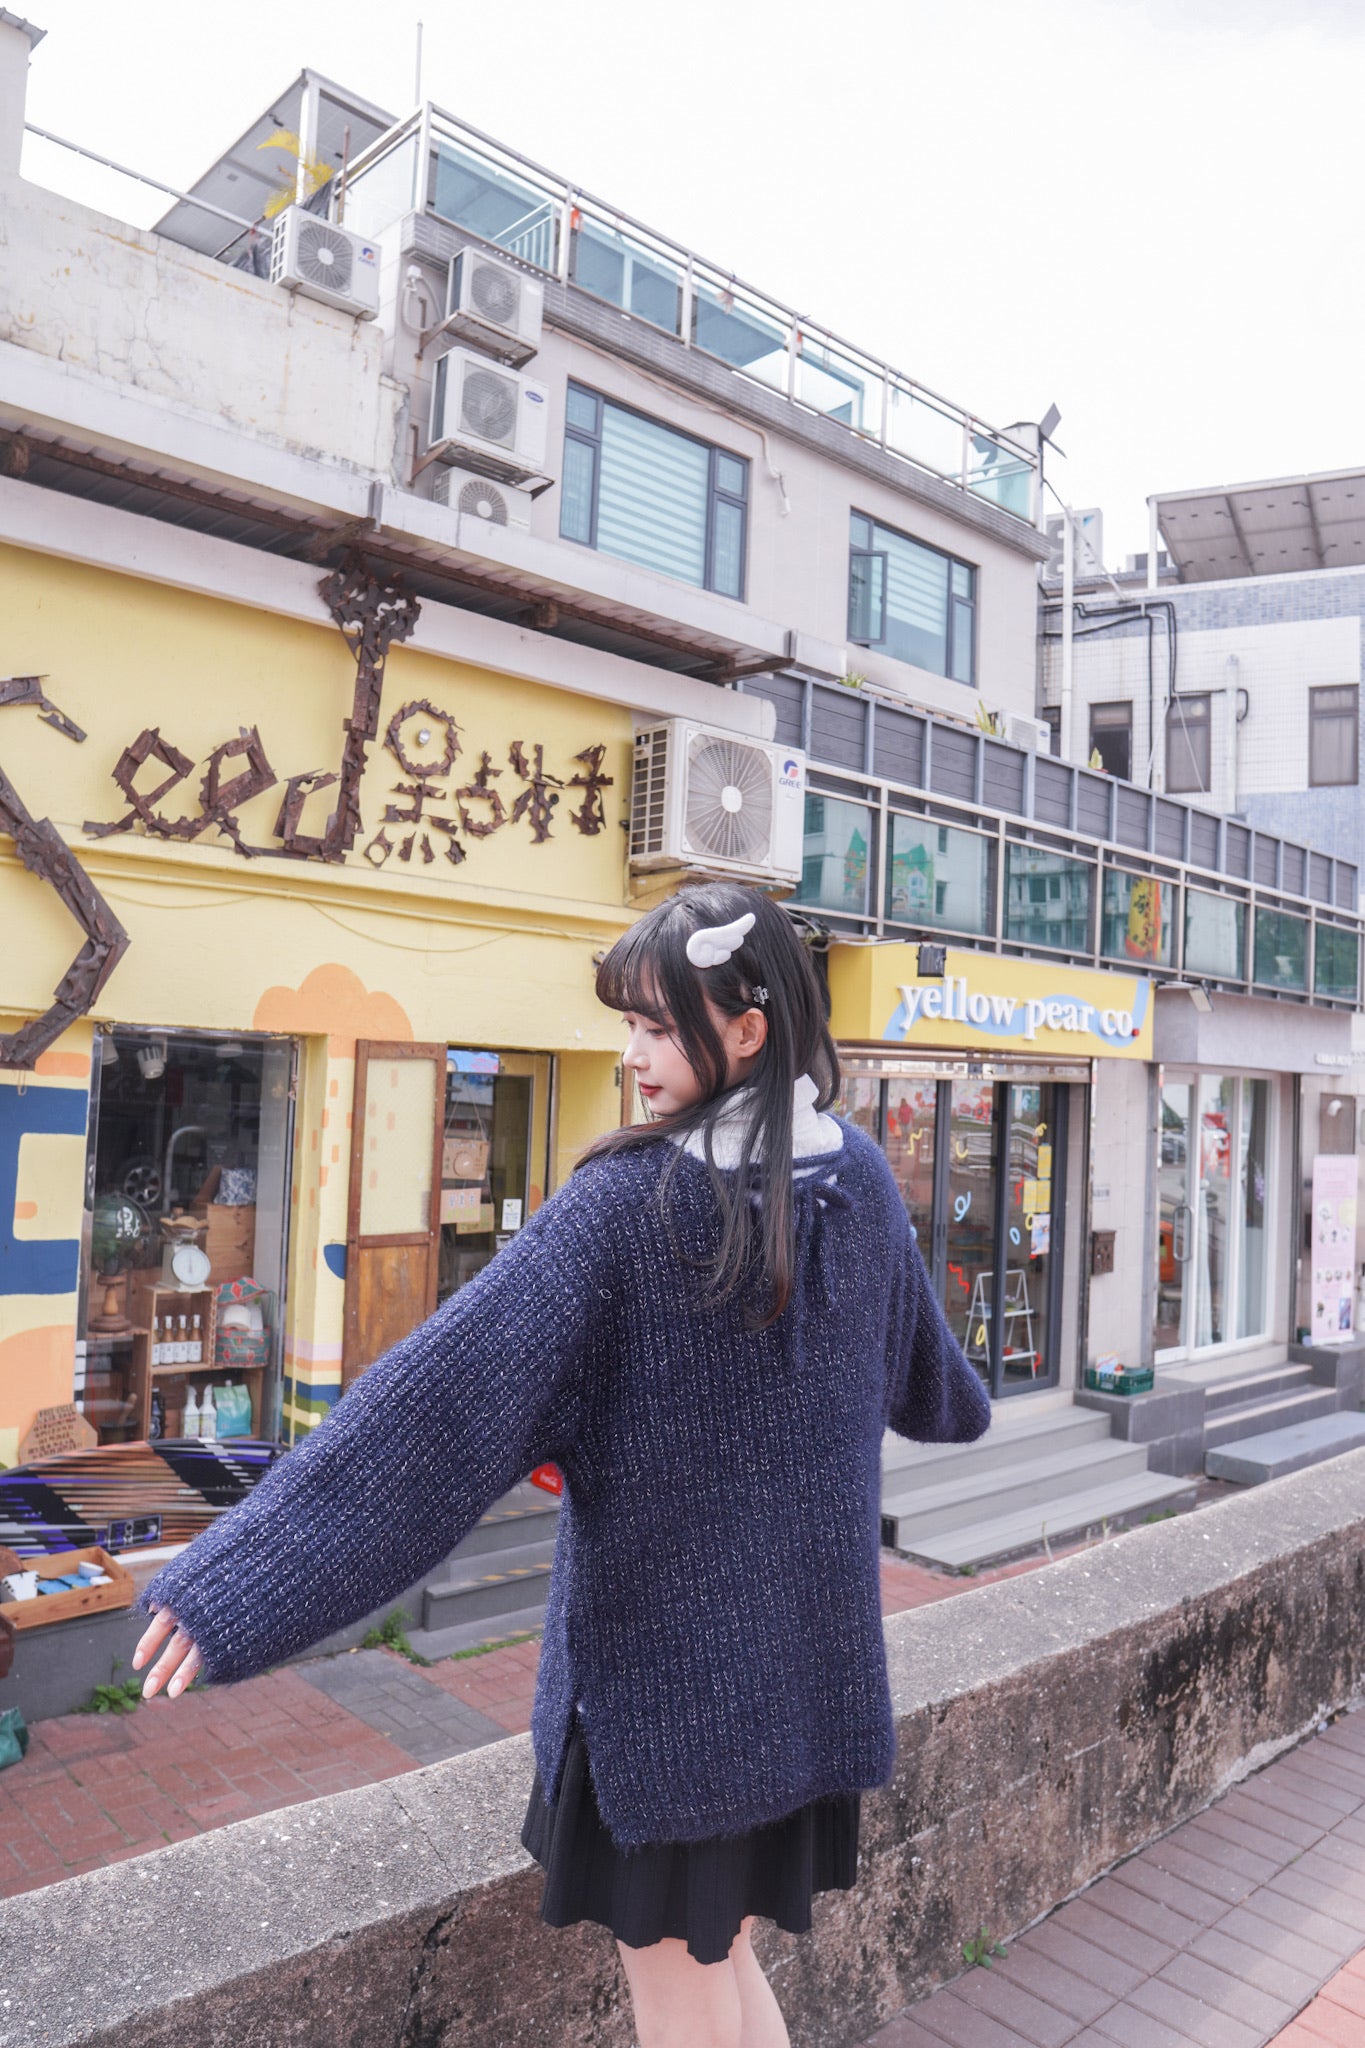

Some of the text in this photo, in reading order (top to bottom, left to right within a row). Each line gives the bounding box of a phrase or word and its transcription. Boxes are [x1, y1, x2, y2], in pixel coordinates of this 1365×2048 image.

[779, 777, 801, 789] GREE
[898, 975, 1140, 1041] yellow pear co.
